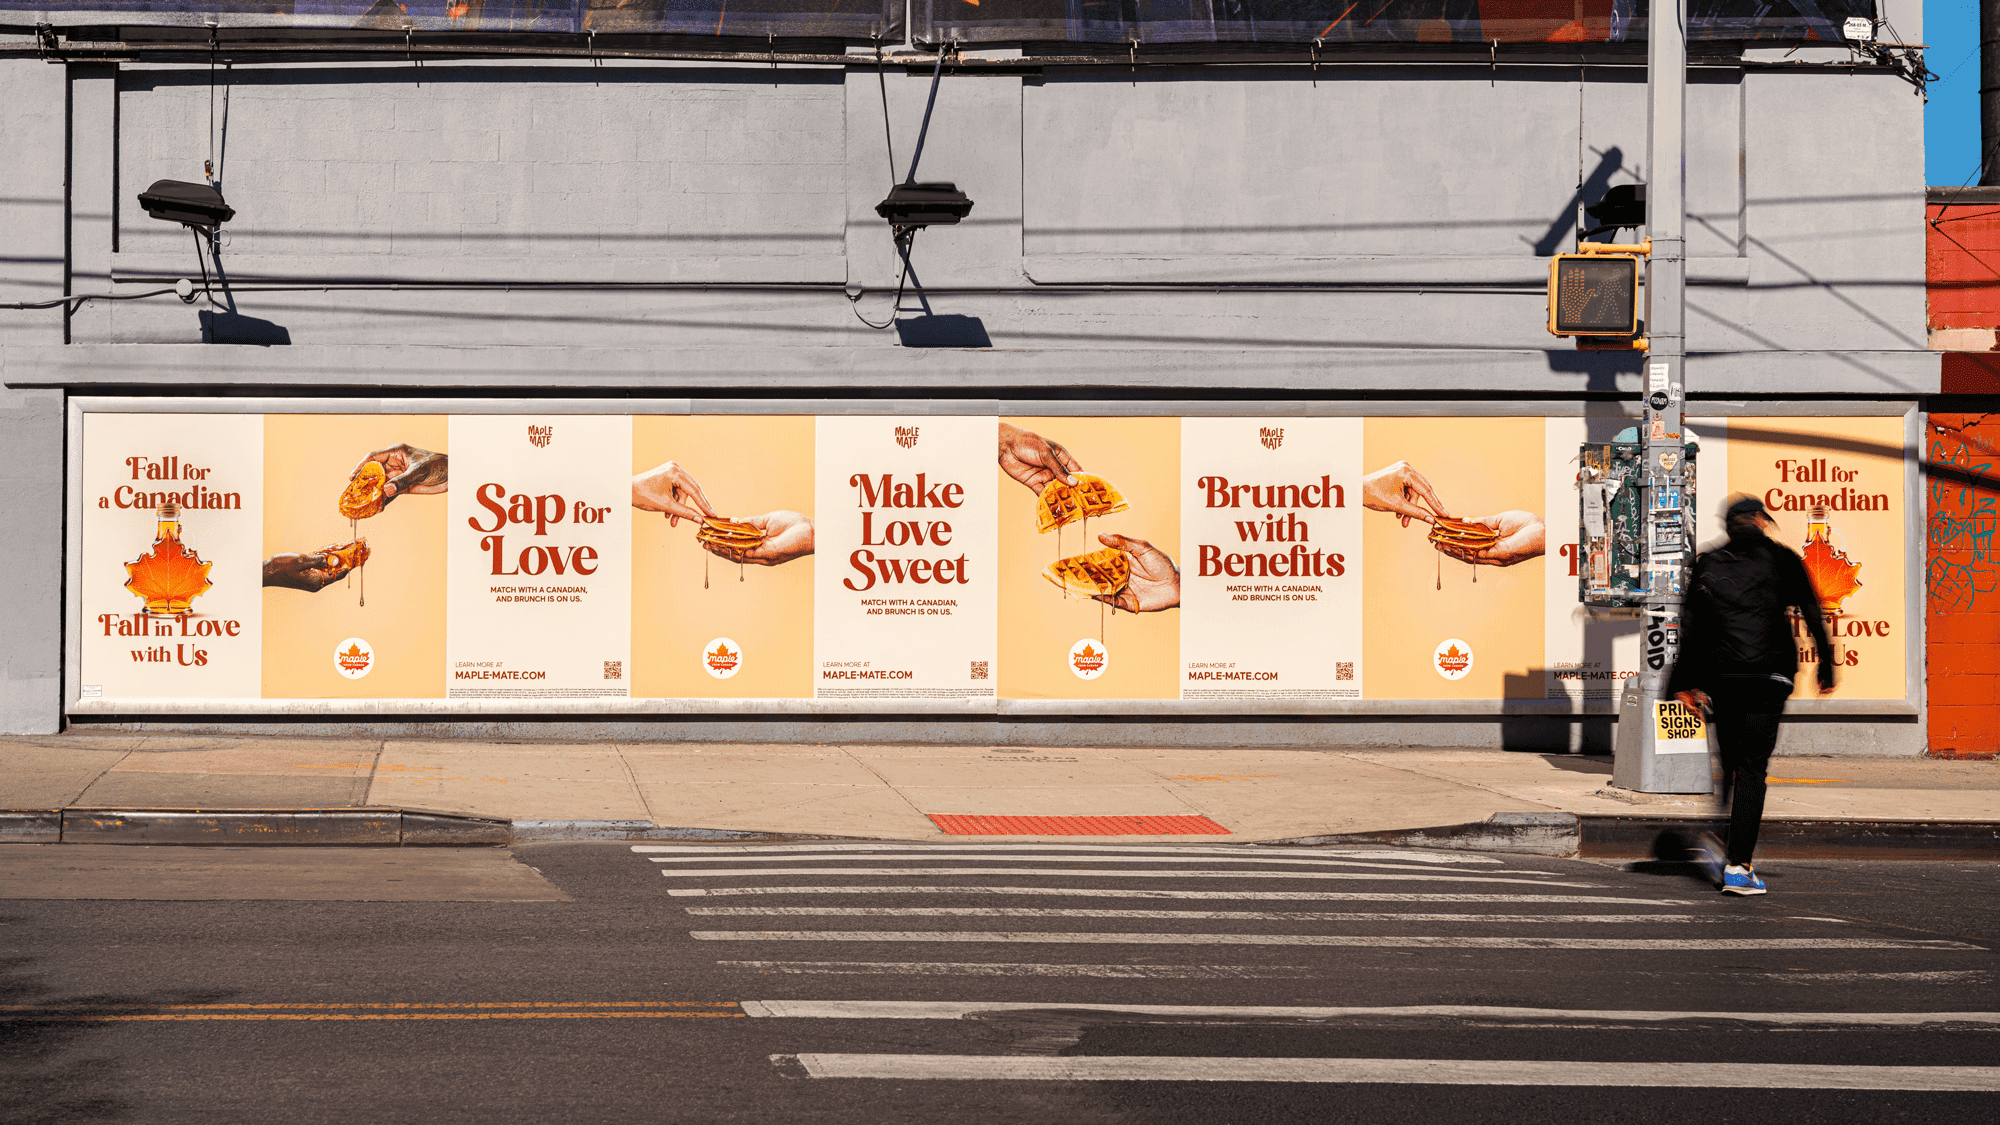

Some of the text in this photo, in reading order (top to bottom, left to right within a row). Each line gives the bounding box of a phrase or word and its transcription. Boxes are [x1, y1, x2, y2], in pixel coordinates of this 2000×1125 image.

[528, 424, 553, 437] MAPLE
[529, 436, 552, 449] MATE
[894, 425, 920, 438] MAPLE
[1259, 426, 1285, 439] MAPLE
[896, 437, 918, 450] MATE
[1261, 438, 1283, 451] MATE
[125, 455, 211, 481] Fall for
[1775, 458, 1859, 483] Fall for
[98, 484, 242, 510] a Canadian
[849, 472, 964, 509] Make
[1197, 474, 1346, 509] Brunch
[1764, 486, 1890, 512] Canadian
[467, 482, 612, 536] Sap for
[861, 511, 952, 547] Love
[1234, 512, 1309, 543] with
[480, 534, 599, 576] Love
[1197, 544, 1345, 577] Benefits
[842, 549, 970, 592] Sweet
[545, 586, 588, 594] CANADIAN,
[1281, 585, 1323, 593] CANADIAN,
[916, 599, 958, 607] CANADIAN,
[97, 612, 241, 637] Fall in Love
[1825, 614, 1891, 638] Love
[130, 643, 208, 667] with Us
[1799, 643, 1859, 667] ith Us
[455, 670, 546, 680] MAPLE-MATE.COM
[823, 670, 913, 680] MAPLE-MATE.COM
[1188, 671, 1278, 681] MAPLE-MATE.COM
[1553, 671, 1639, 681] MAPLE-MATE.CO
[1661, 716, 1702, 729] SIGNS
[1667, 728, 1697, 739] SHOP
